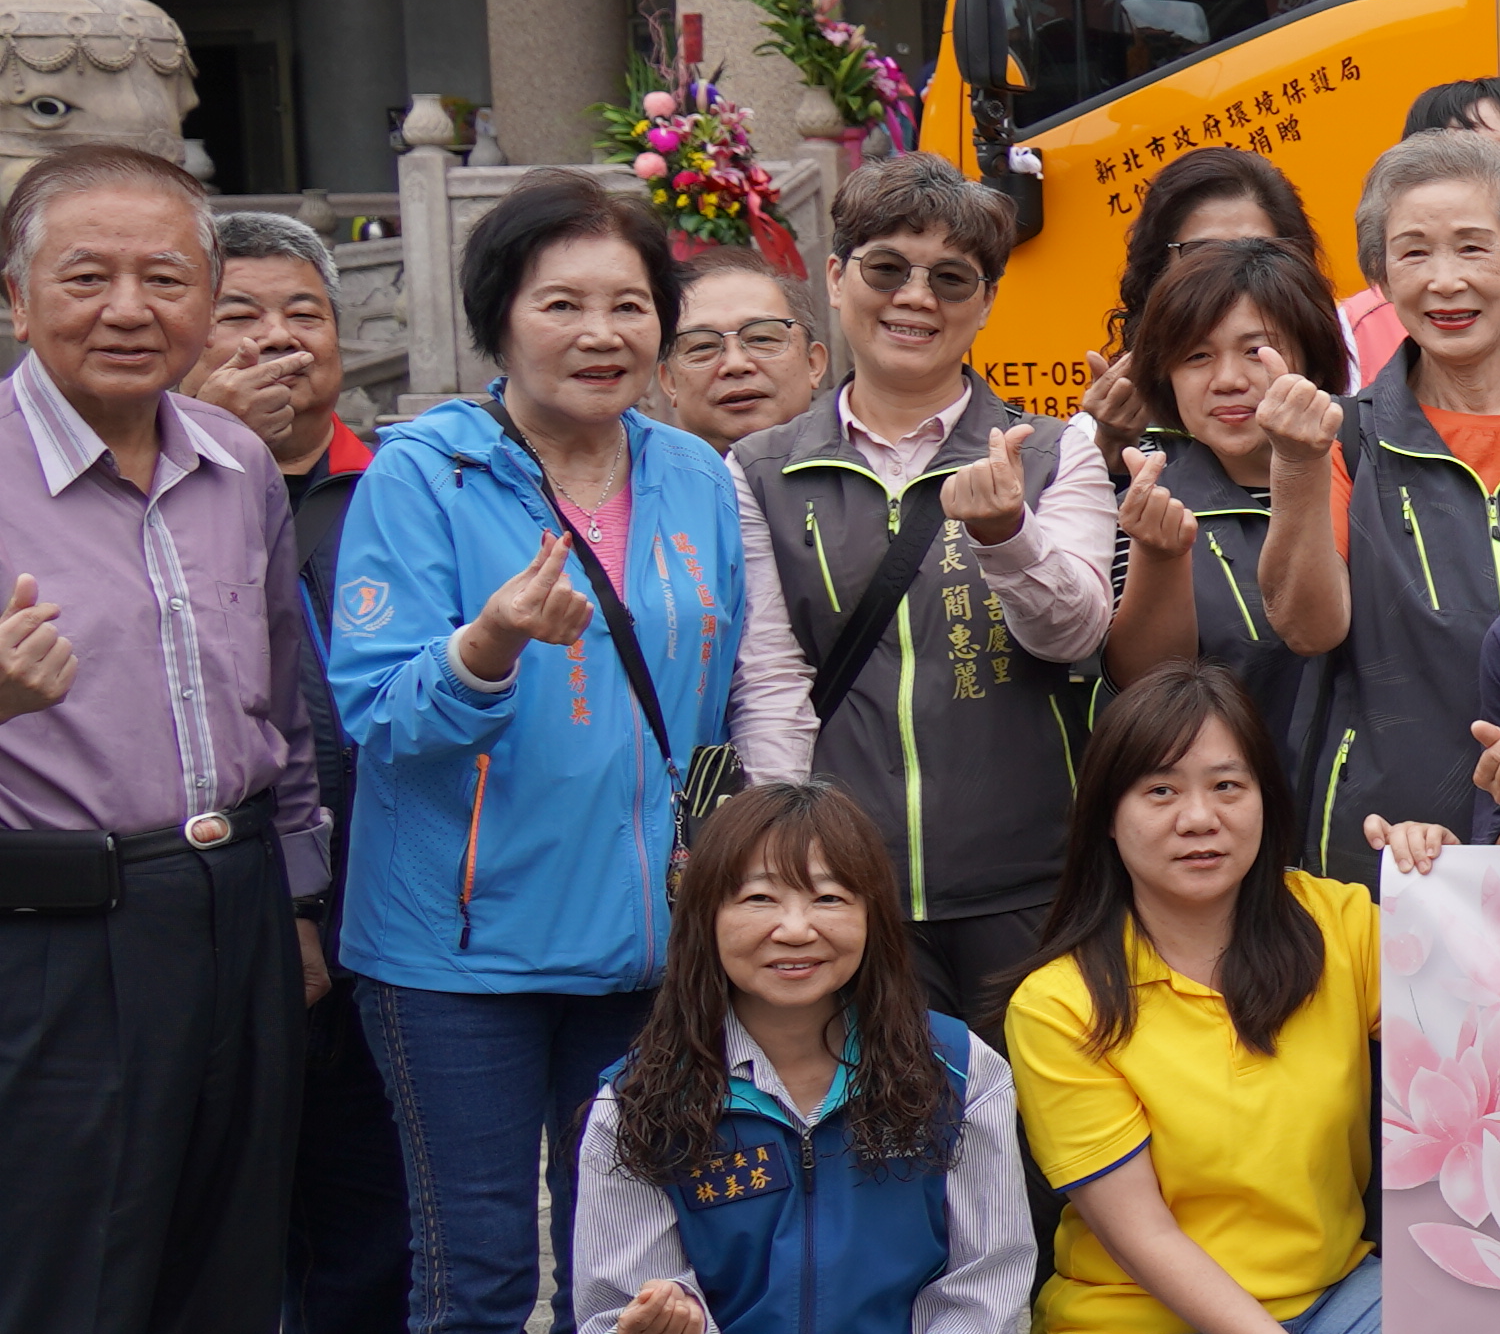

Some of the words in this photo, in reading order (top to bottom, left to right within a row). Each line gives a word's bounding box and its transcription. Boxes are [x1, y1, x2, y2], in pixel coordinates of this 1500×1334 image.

[1095, 56, 1361, 184] 新北市政府環境保護局
[938, 519, 968, 574] 里長
[941, 583, 986, 700] 簡惠麗
